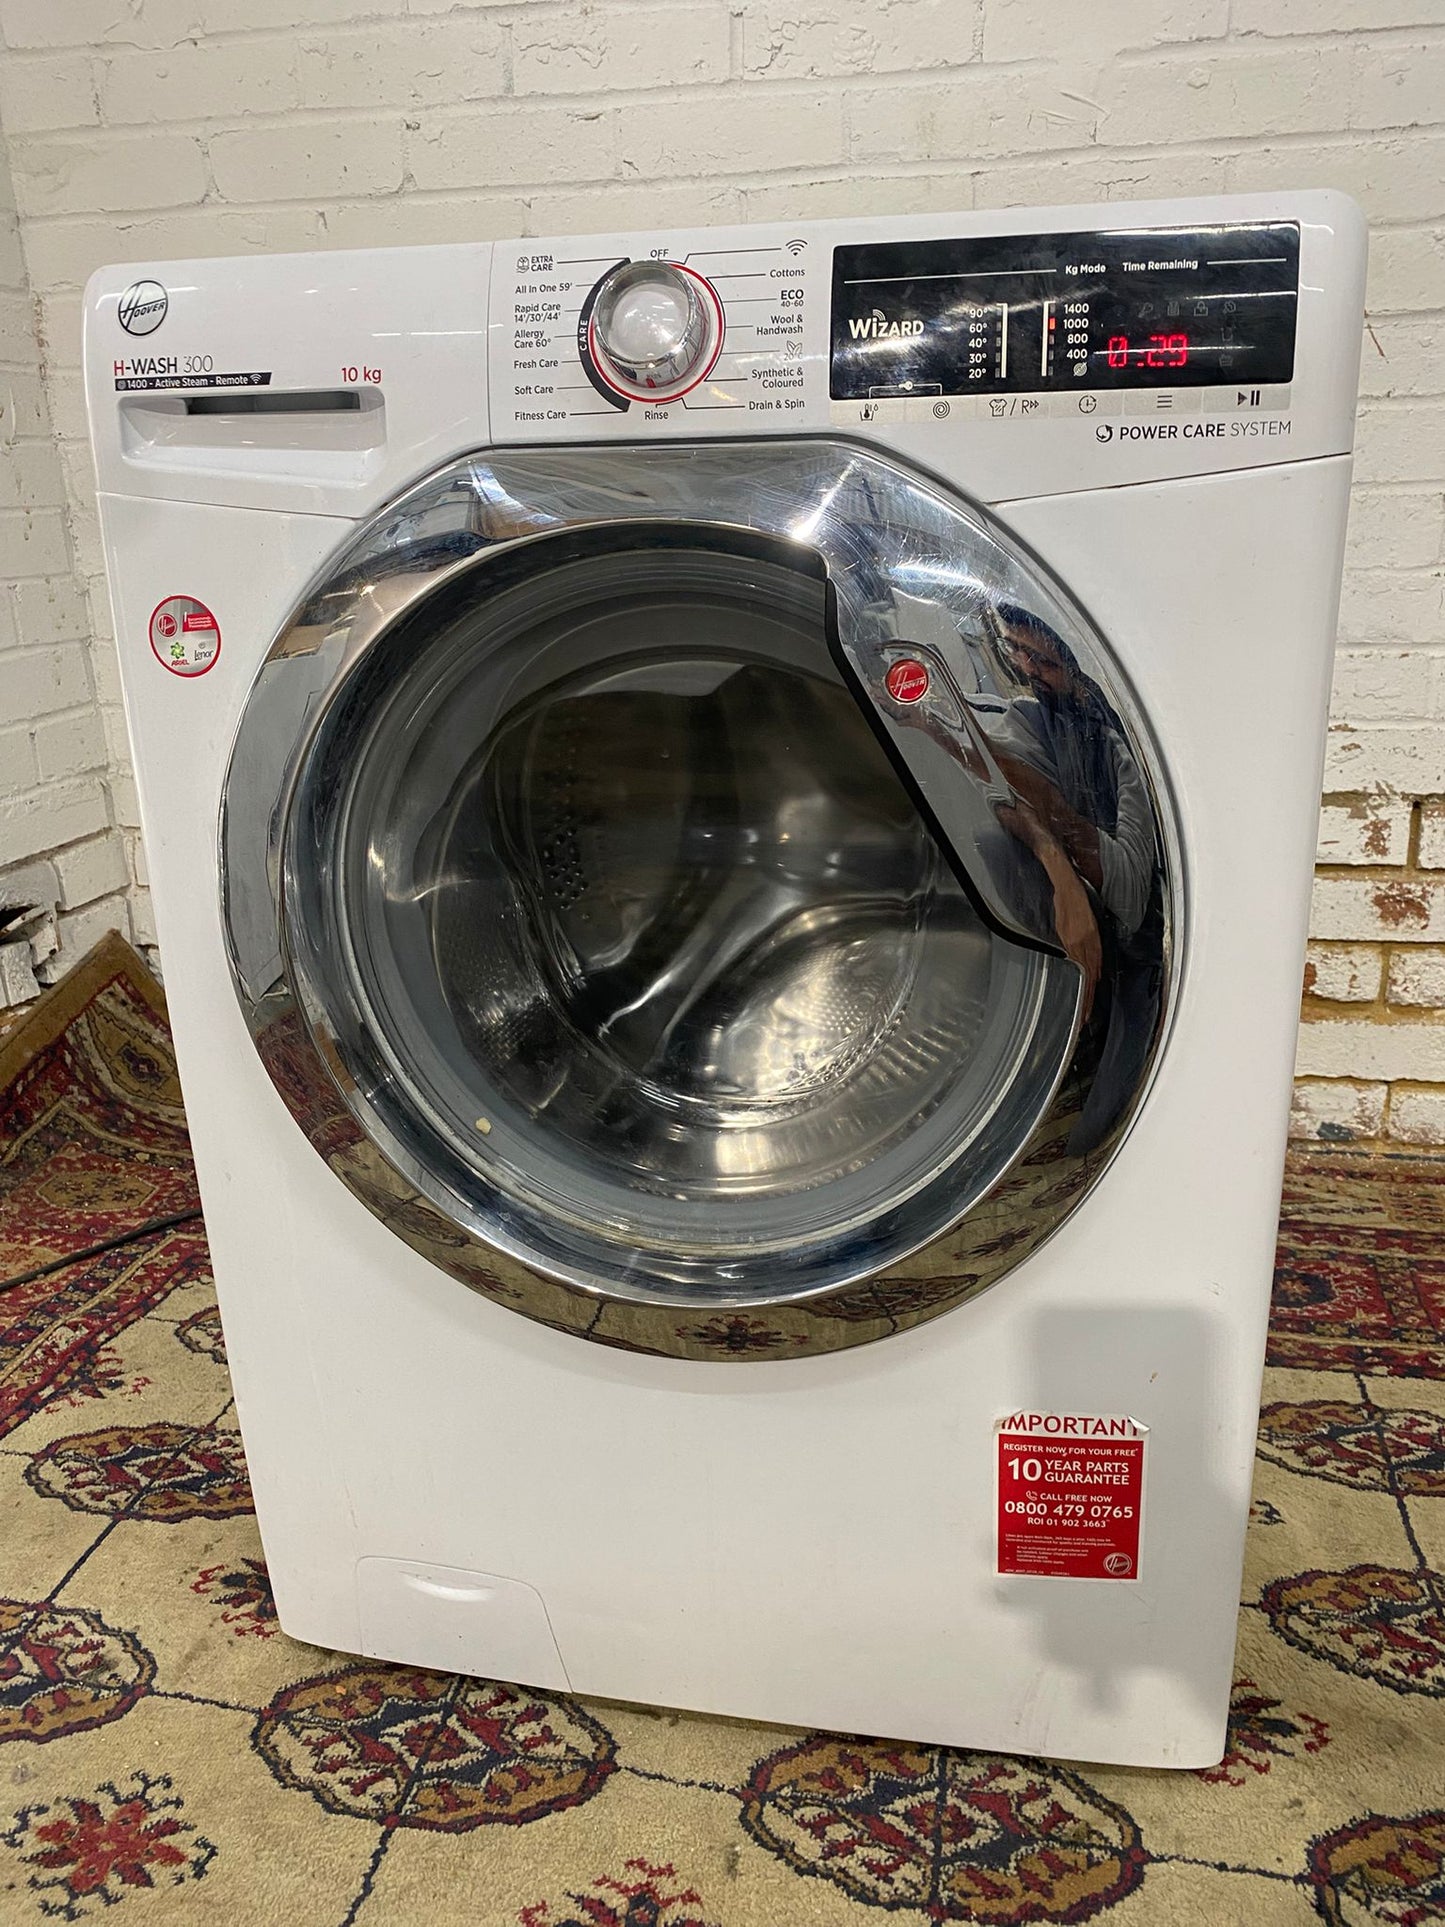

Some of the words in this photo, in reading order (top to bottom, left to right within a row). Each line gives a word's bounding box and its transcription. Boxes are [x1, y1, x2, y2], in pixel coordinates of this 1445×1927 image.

[650, 249, 669, 258] OFF
[531, 255, 553, 264] EXTRA
[531, 263, 553, 272] CARE
[1065, 265, 1078, 276] Kg
[1080, 263, 1106, 274] Mode
[1123, 262, 1146, 272] Time
[1148, 259, 1198, 270] Remaining
[769, 268, 805, 278] Cottons
[515, 285, 528, 294] All
[529, 285, 537, 293] In
[539, 284, 557, 293] One
[559, 283, 573, 291] 59'
[780, 289, 804, 300] ECO
[514, 303, 539, 314] Rapid
[541, 303, 561, 312] Care
[1064, 303, 1090, 314] 1400
[770, 314, 794, 324] Wool
[796, 314, 803, 323] &
[1063, 318, 1089, 329] 1000
[514, 330, 545, 340] Allergy
[579, 319, 589, 350] CARE
[756, 325, 803, 336] Handwash
[1067, 333, 1088, 344] 800
[514, 340, 533, 349] Care
[1066, 348, 1088, 359] 400
[114, 357, 178, 376] H-WASH
[183, 355, 213, 373] 300
[514, 359, 537, 370] Fresh
[539, 359, 559, 368] Care
[341, 366, 357, 382] 10
[364, 366, 382, 383] kg
[752, 367, 795, 379] Synthetic
[797, 367, 803, 376] &
[128, 379, 148, 389] 1400
[155, 378, 181, 388] Active
[182, 376, 209, 387] Steam
[216, 375, 249, 386] Remote
[762, 378, 804, 388] Coloured
[514, 386, 531, 395] Soft
[533, 385, 554, 394] Care
[749, 400, 773, 410] Drain
[776, 400, 782, 409] &
[785, 399, 805, 410] Spin
[514, 411, 545, 421] Fitness
[547, 410, 567, 419] Care
[644, 410, 669, 420] Rinse
[1120, 425, 1178, 440] POWER
[1183, 423, 1226, 438] CARE
[1230, 421, 1292, 437] SYSTEM
[194, 650, 214, 661] Lenor
[1004, 1443, 1043, 1453] REGISTER
[1069, 1447, 1086, 1455] FOR
[1088, 1448, 1112, 1457] YOUR
[1008, 1457, 1042, 1482] 10
[1045, 1459, 1081, 1472] YEAR
[1087, 1461, 1129, 1473] PARTS
[1044, 1472, 1130, 1486] GUARANTEE
[1040, 1492, 1063, 1501] CALL
[1065, 1494, 1087, 1502] FREE
[1090, 1495, 1113, 1503] NOW
[1004, 1501, 1047, 1515] 0800
[1053, 1504, 1085, 1517] 479
[1090, 1505, 1133, 1519] 0765
[1027, 1517, 1044, 1525] ROI
[1046, 1518, 1058, 1526] 01
[1061, 1519, 1080, 1527] 902
